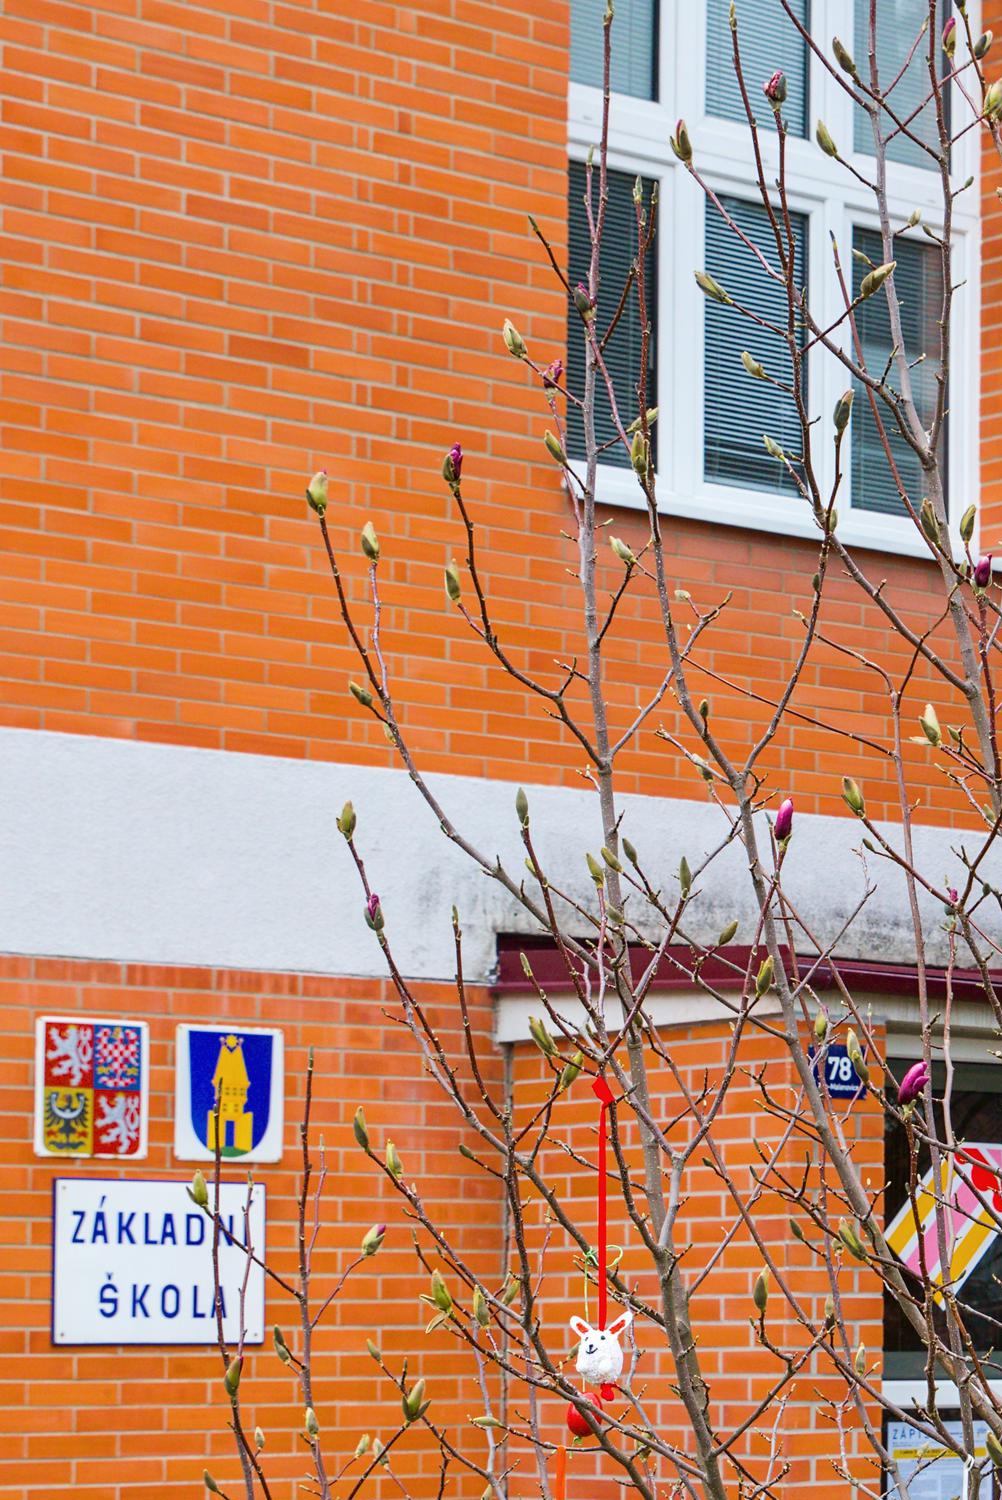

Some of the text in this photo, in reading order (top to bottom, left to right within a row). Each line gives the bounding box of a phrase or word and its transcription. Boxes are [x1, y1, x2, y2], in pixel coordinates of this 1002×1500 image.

[827, 1056, 853, 1082] 78
[71, 1195, 254, 1247] ZÁKLADNÍ
[99, 1272, 227, 1319] ŠKOLA
